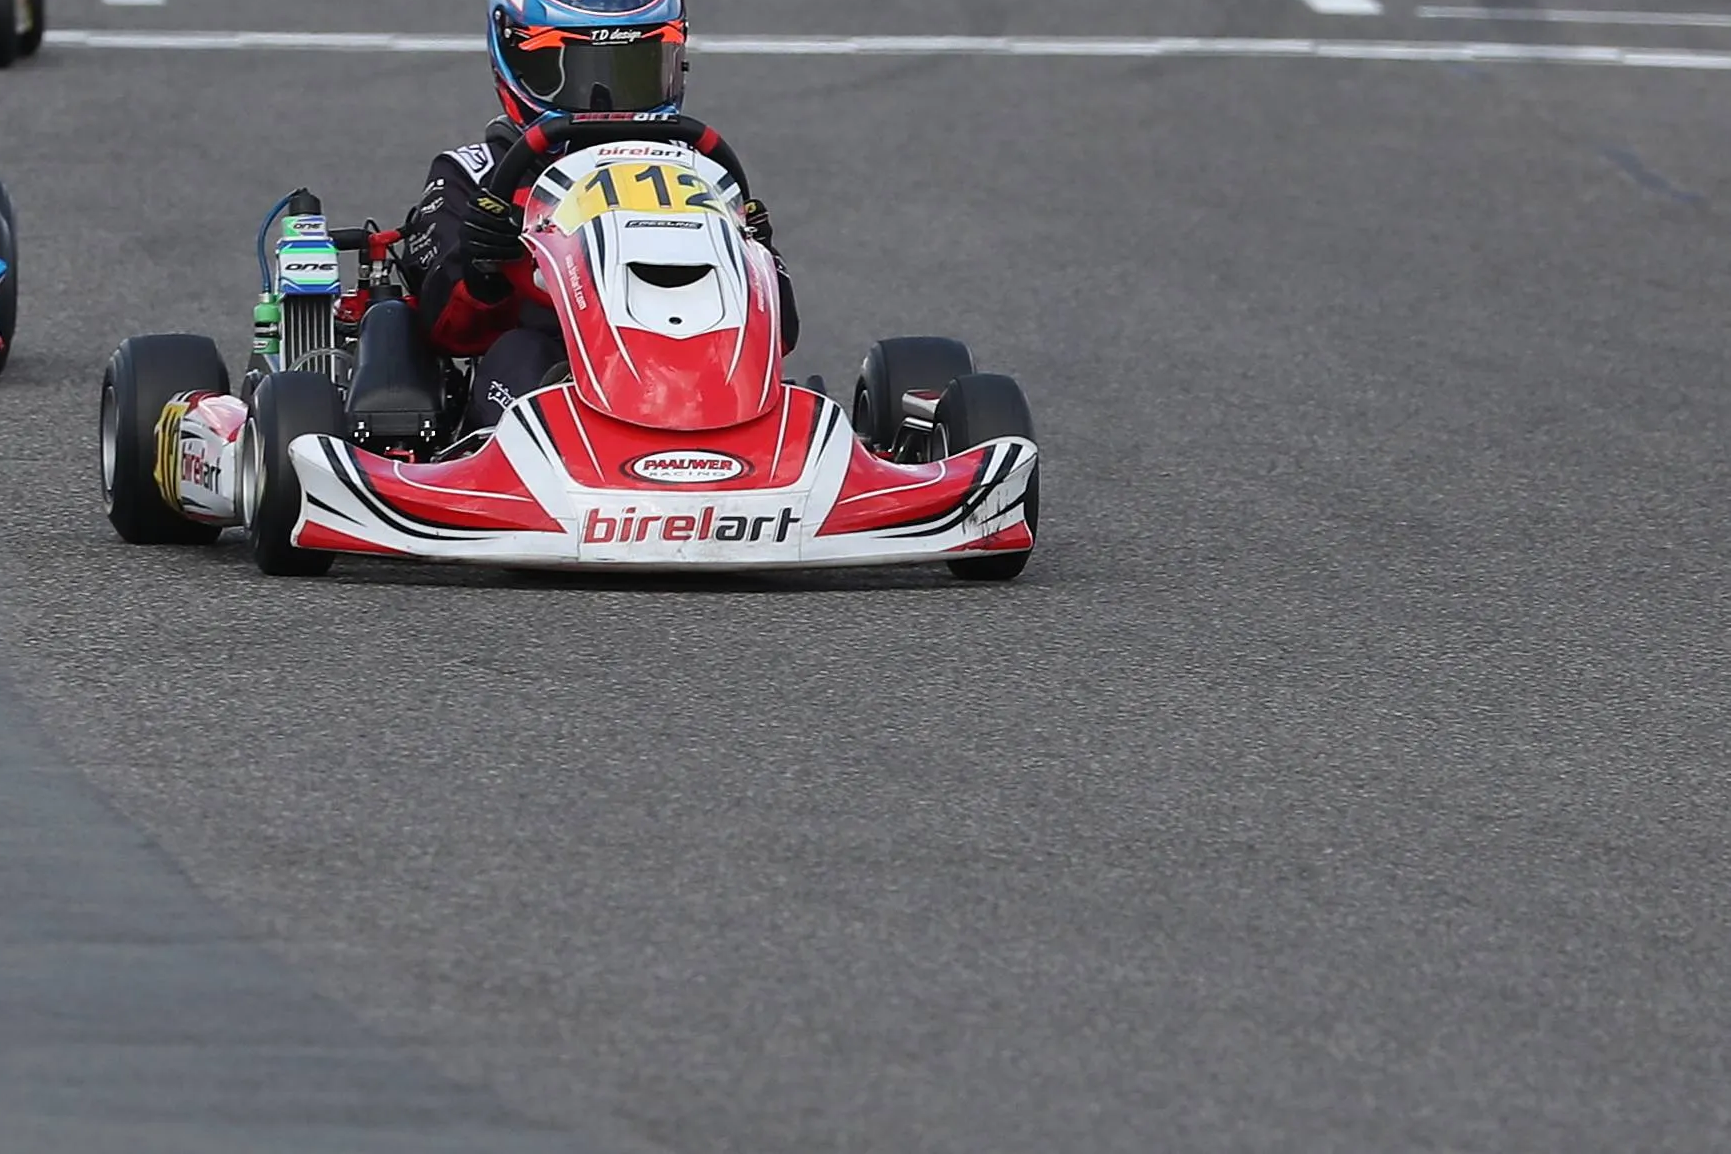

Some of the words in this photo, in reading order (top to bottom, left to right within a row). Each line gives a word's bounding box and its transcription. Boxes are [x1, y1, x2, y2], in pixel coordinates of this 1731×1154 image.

[599, 147, 687, 158] birelart
[585, 165, 729, 216] 112
[293, 222, 323, 230] ONE
[285, 263, 337, 271] ONE
[643, 458, 733, 471] PAAUWER
[582, 506, 801, 544] birelart
